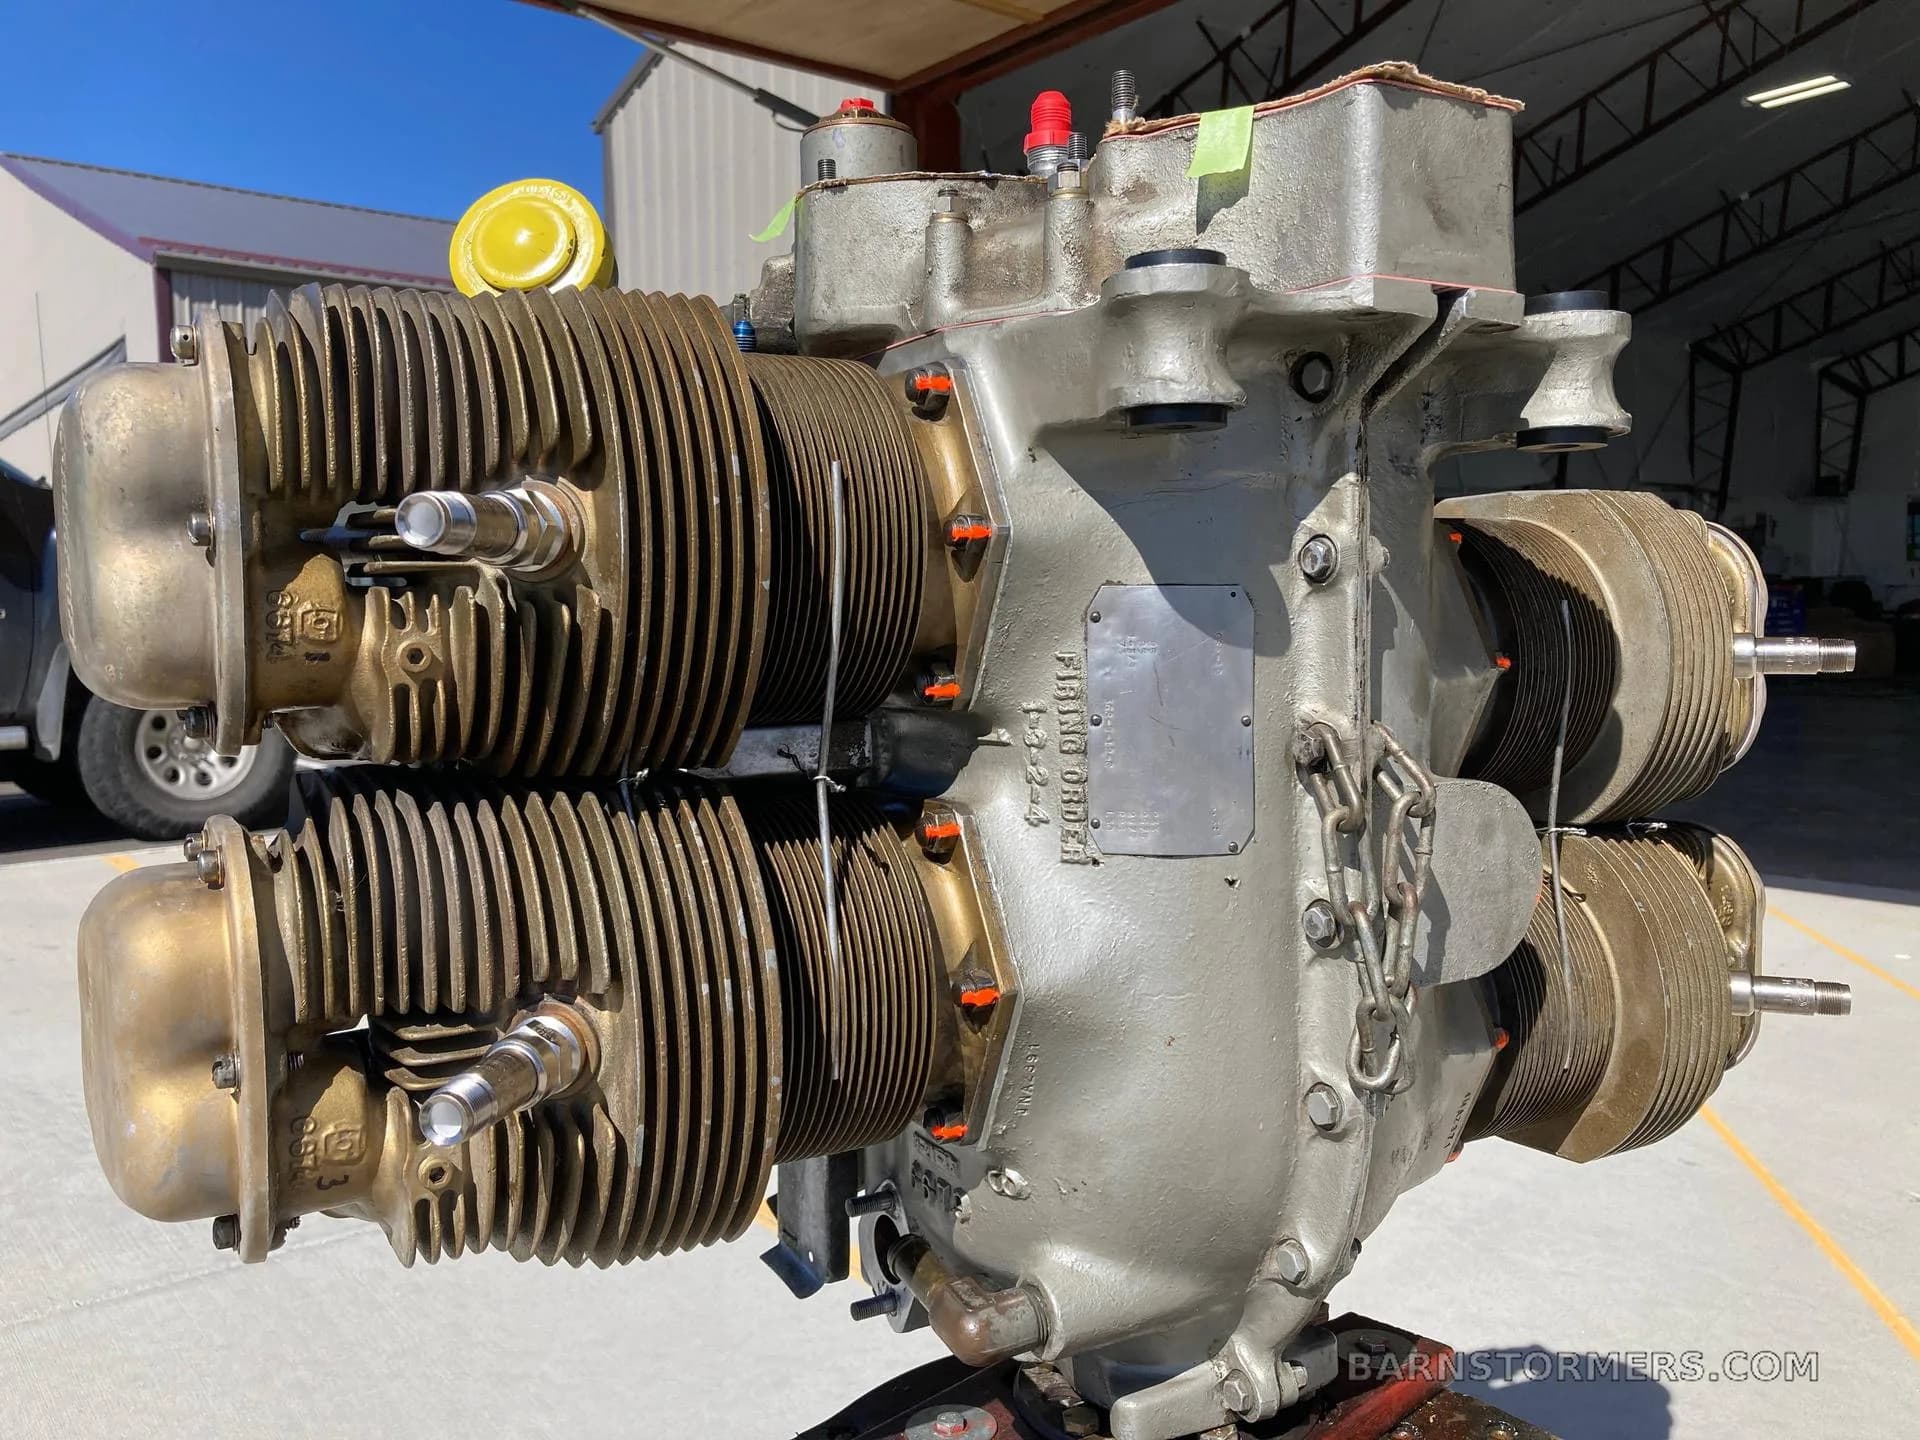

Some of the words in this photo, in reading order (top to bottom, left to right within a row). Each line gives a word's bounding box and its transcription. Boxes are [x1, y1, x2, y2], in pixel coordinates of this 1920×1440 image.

[1054, 650, 1087, 754] FIRING
[1018, 700, 1050, 826] 1-3-2-4
[1060, 766, 1091, 865] ORDER
[318, 1174, 350, 1190] 3
